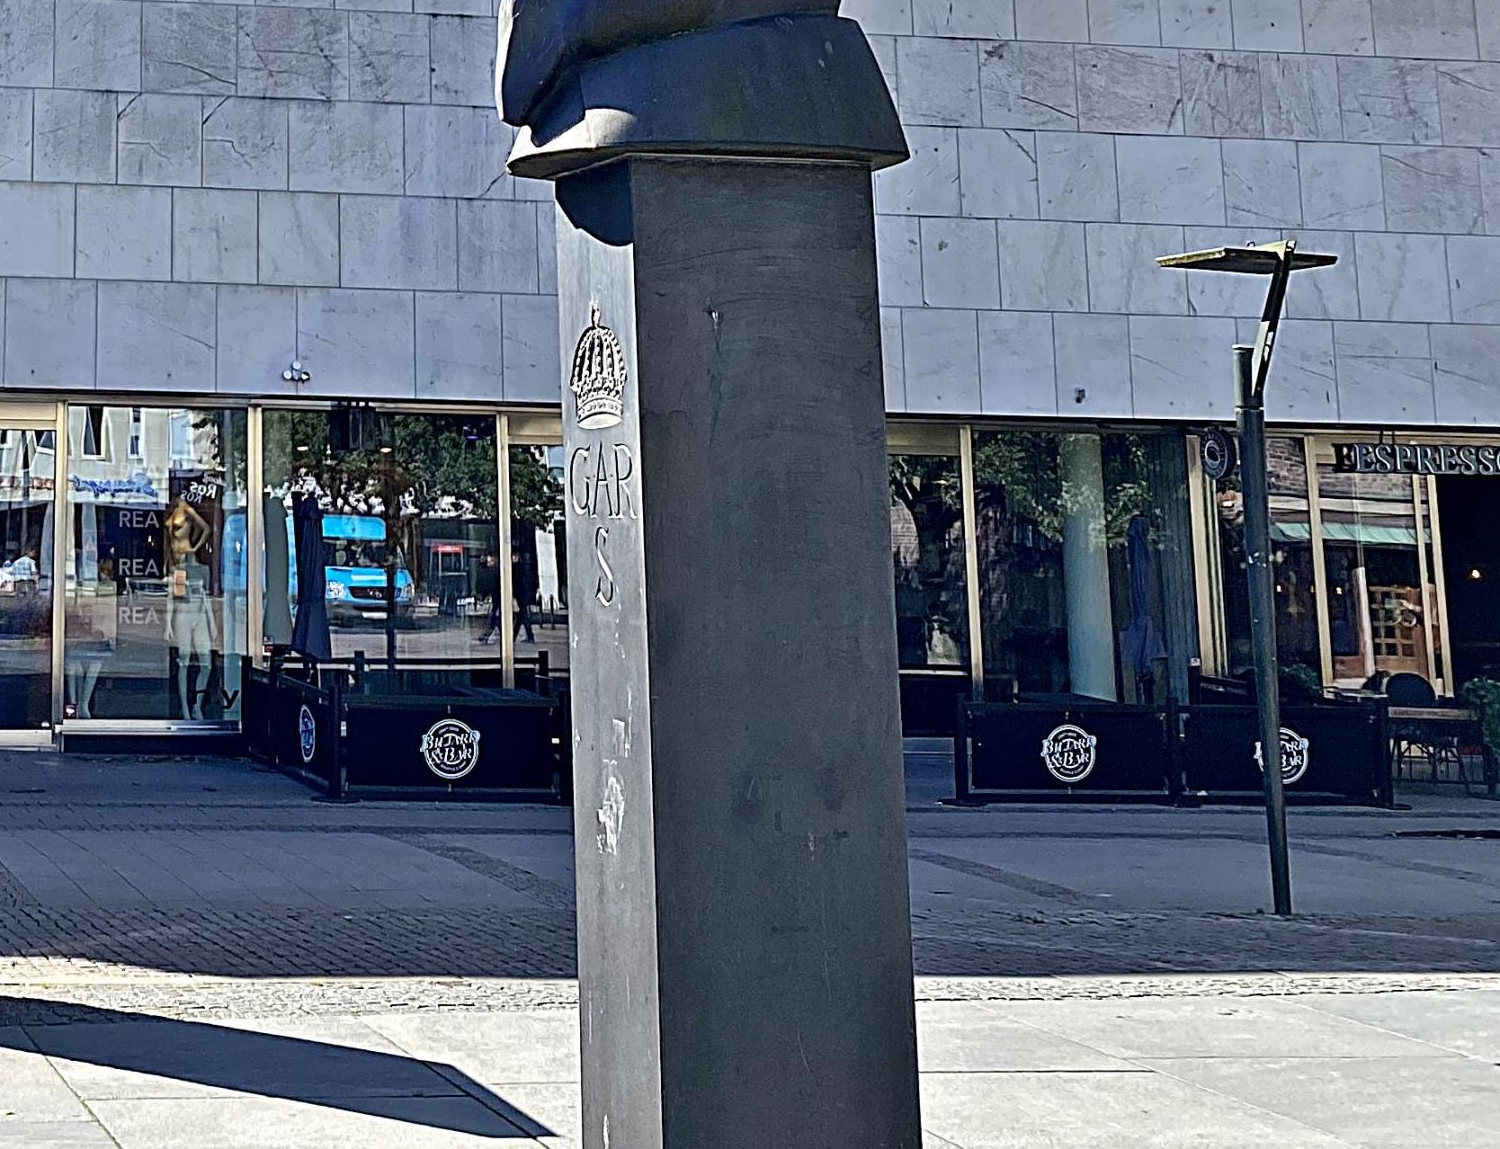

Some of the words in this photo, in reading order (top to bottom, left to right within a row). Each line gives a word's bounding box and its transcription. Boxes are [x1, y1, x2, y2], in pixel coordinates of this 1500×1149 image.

[1353, 443, 1500, 475] ESPRESS
[119, 511, 160, 529] REA
[118, 558, 160, 576] REA
[118, 606, 160, 625] REA
